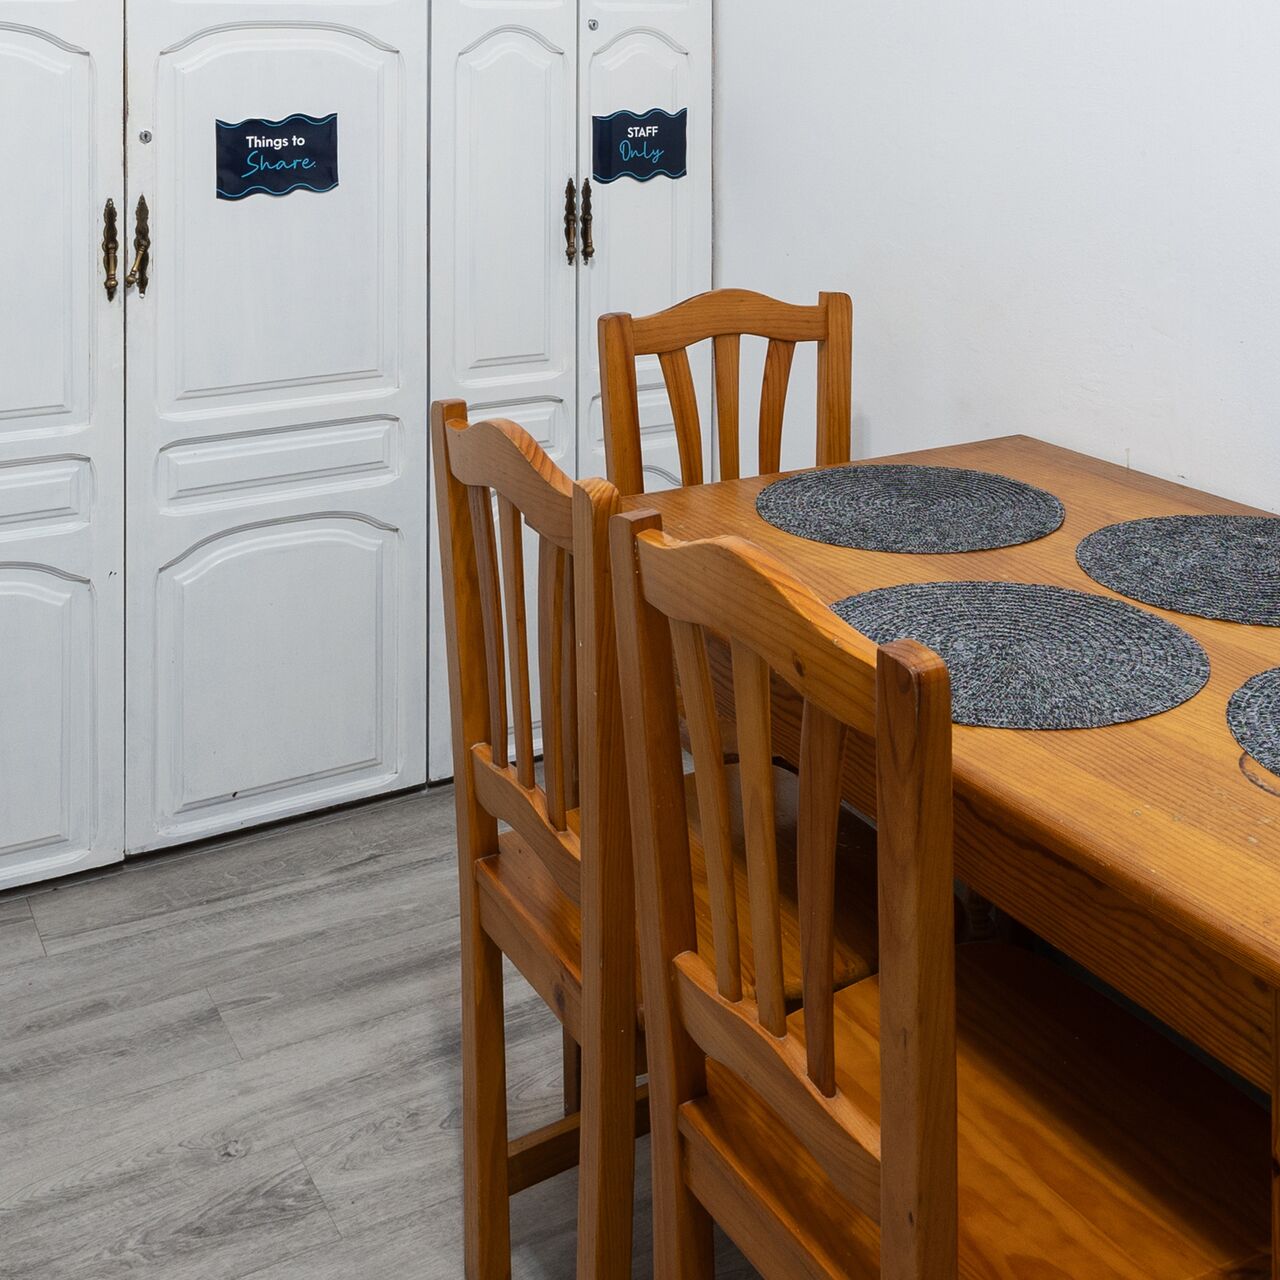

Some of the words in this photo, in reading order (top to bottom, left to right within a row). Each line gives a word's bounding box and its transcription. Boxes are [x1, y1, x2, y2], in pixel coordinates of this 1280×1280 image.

[627, 125, 659, 138] STAFF
[245, 136, 289, 150] Things
[292, 135, 305, 146] to
[619, 139, 664, 164] Only
